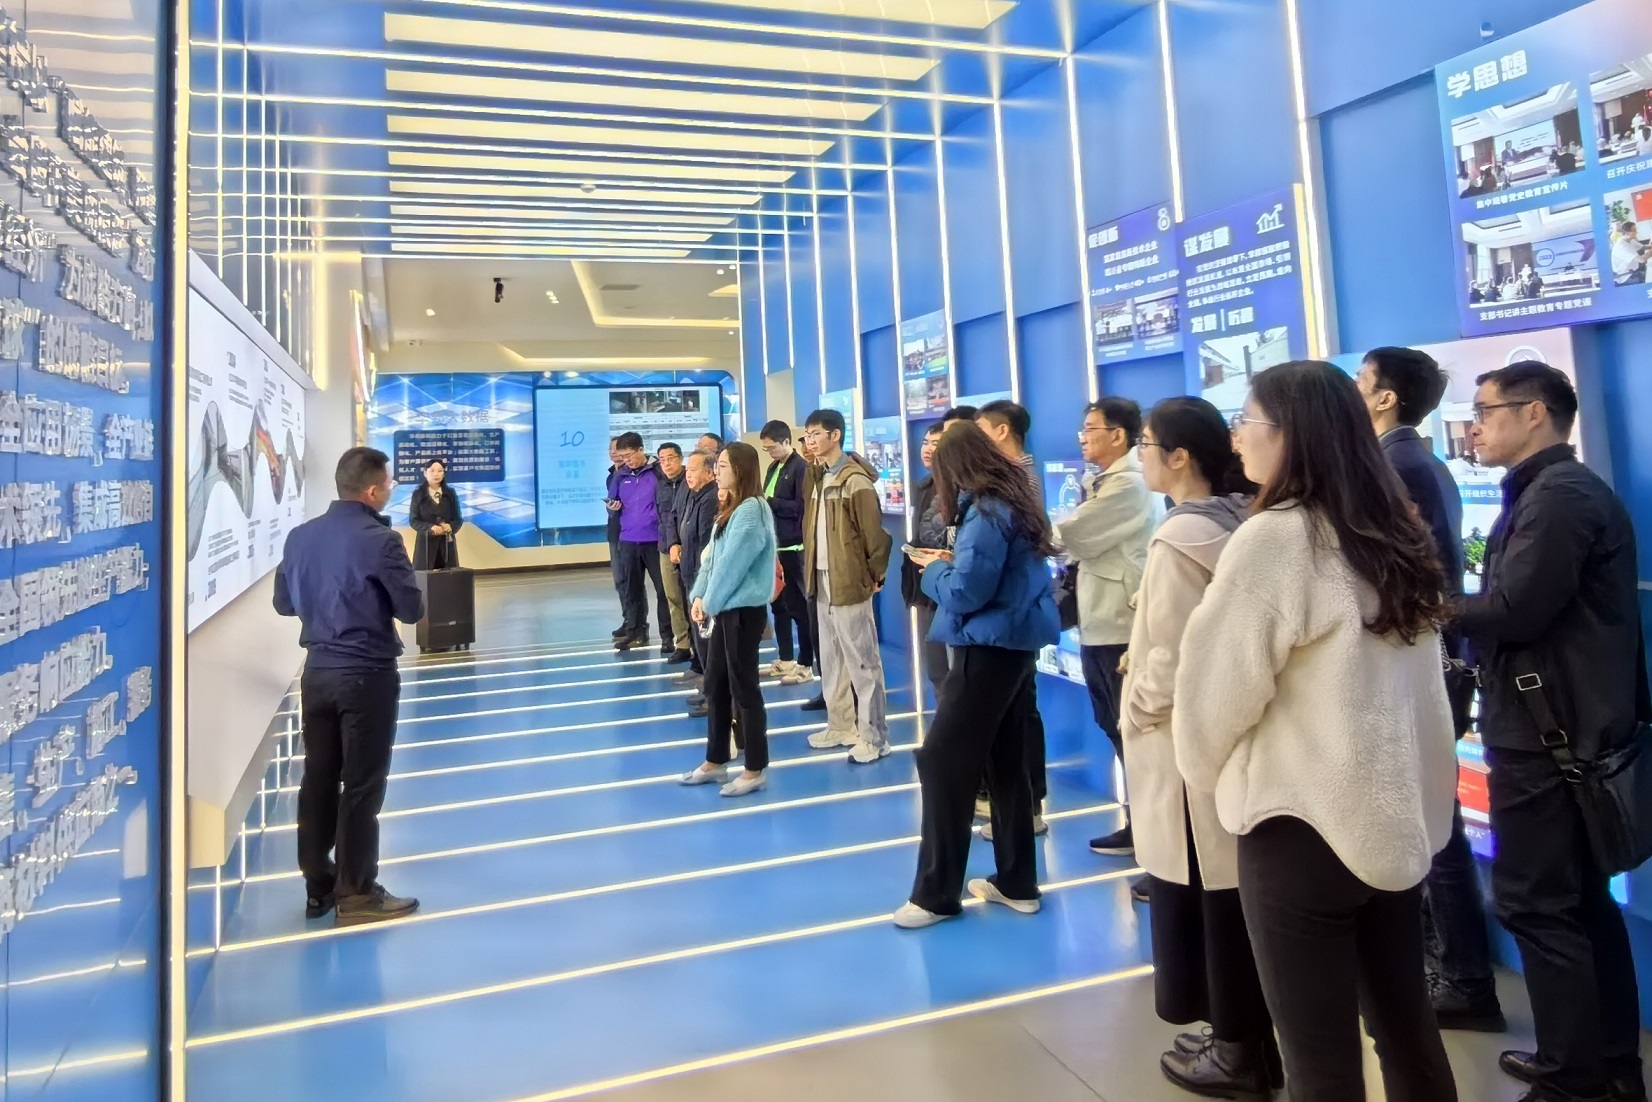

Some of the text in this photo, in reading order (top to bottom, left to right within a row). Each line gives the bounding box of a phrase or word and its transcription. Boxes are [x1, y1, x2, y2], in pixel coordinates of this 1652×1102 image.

[1446, 49, 1528, 99] 学思想
[559, 430, 585, 447] 10
